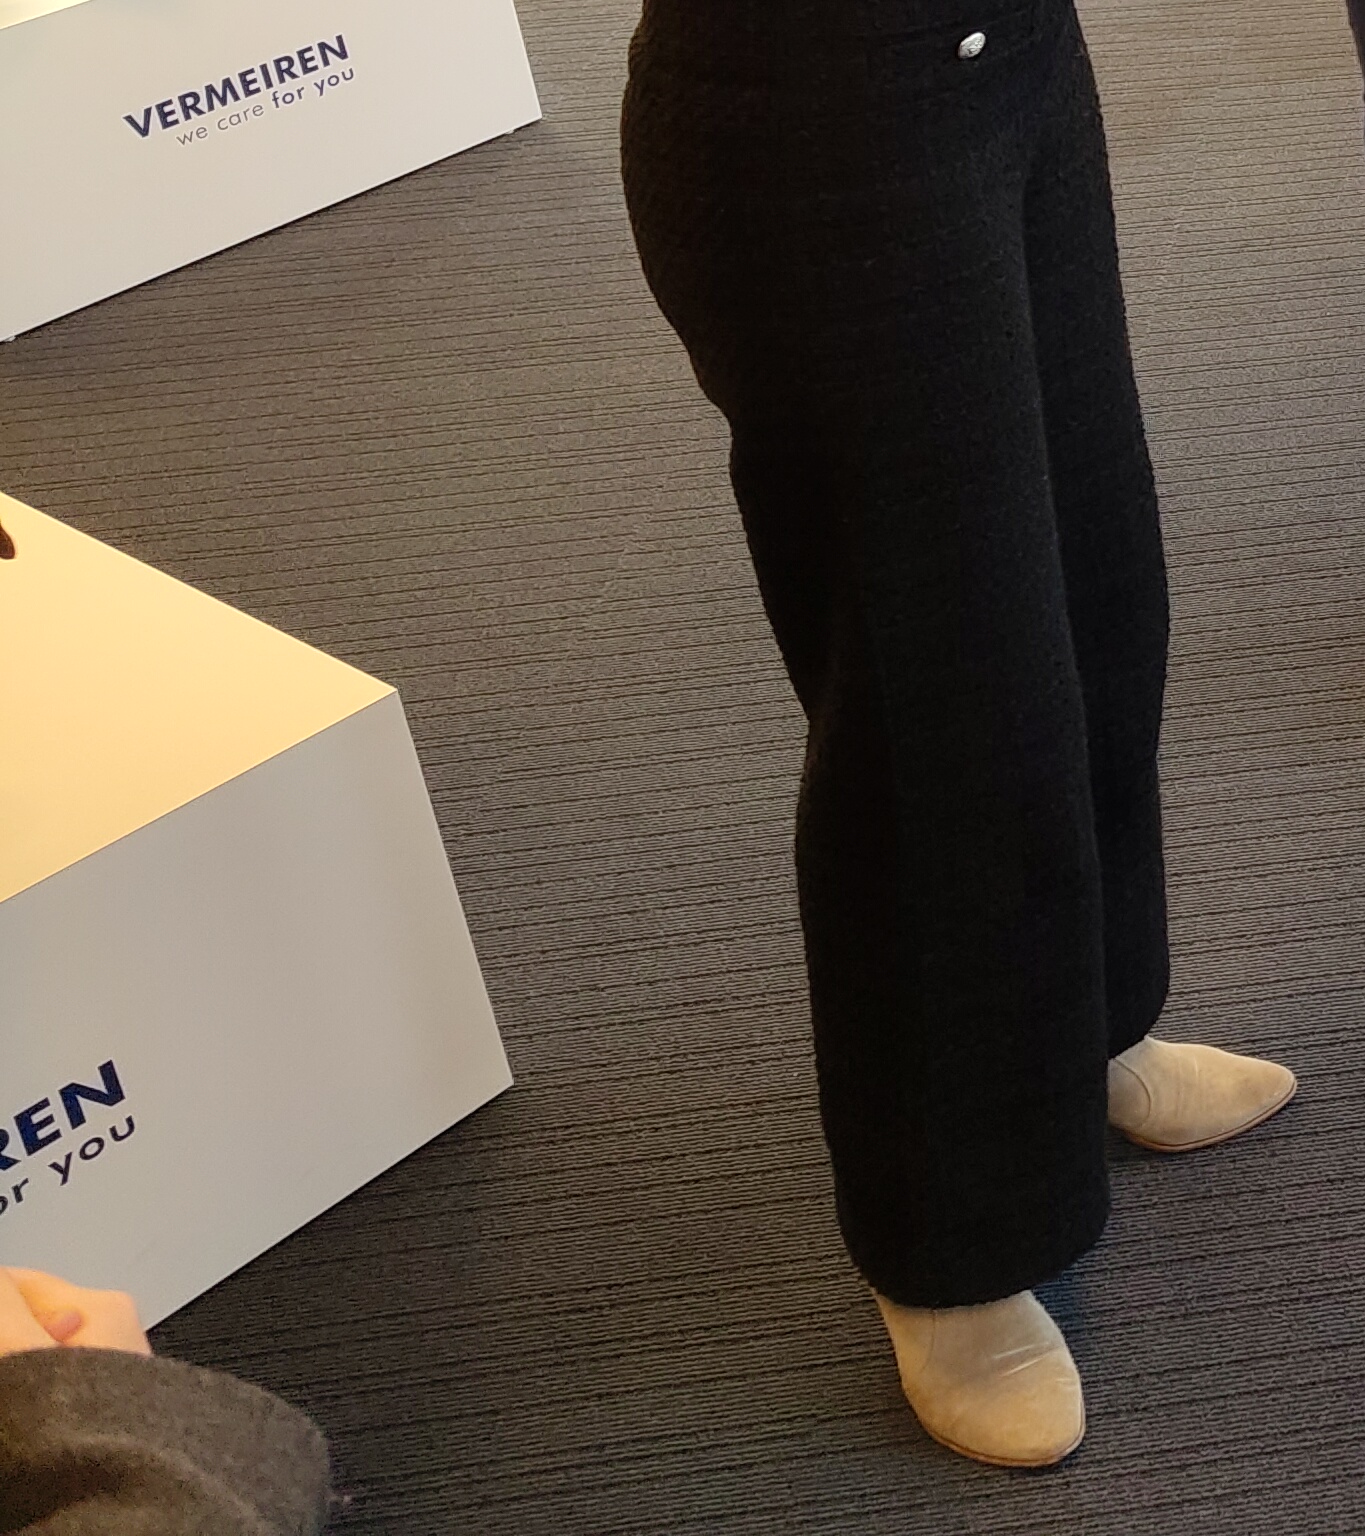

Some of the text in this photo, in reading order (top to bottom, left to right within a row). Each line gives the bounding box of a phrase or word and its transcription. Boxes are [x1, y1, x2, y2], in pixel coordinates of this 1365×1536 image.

[123, 34, 349, 138] VERMEIREN
[176, 67, 354, 146] we care for you
[48, 1115, 136, 1186] you
